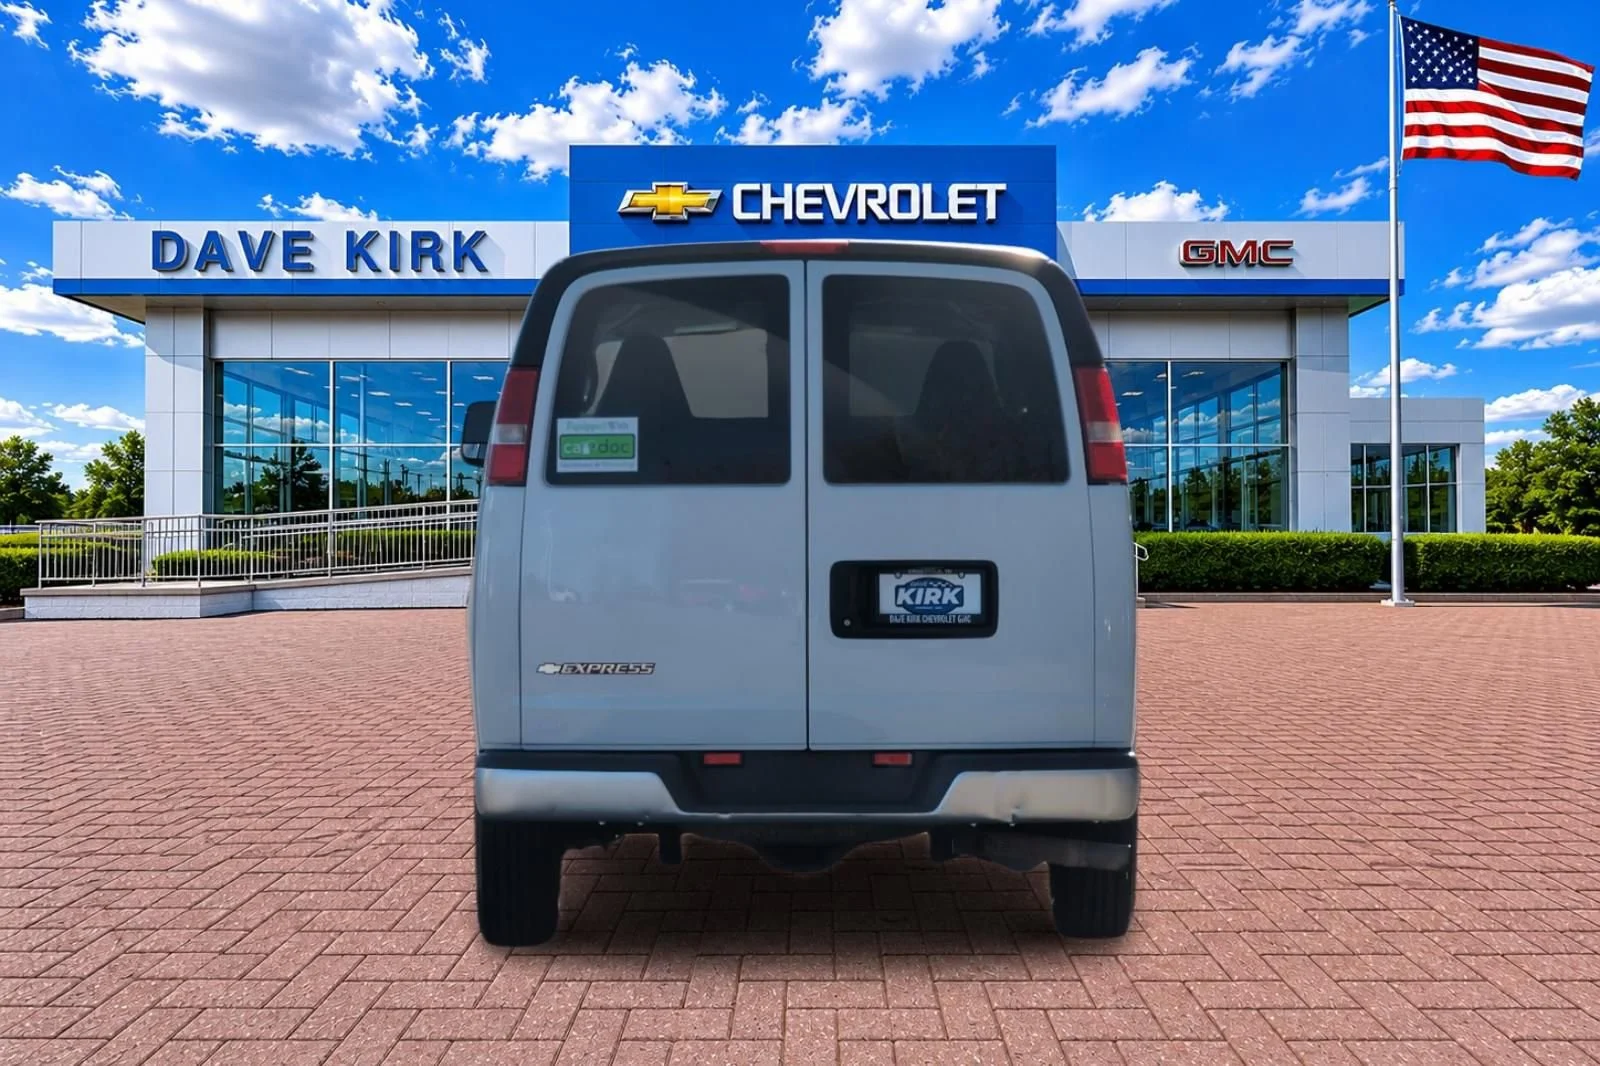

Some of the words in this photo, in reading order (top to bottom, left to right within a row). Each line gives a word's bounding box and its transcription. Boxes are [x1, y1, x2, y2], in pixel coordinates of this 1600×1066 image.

[732, 183, 1007, 221] CHEVROLET
[152, 230, 315, 273] DAVE
[346, 230, 488, 273] KIRK
[1180, 240, 1294, 267] GMC
[896, 587, 963, 605] KIRK
[922, 614, 956, 624] CHEVROLET
[560, 662, 655, 675] EXPRESS
